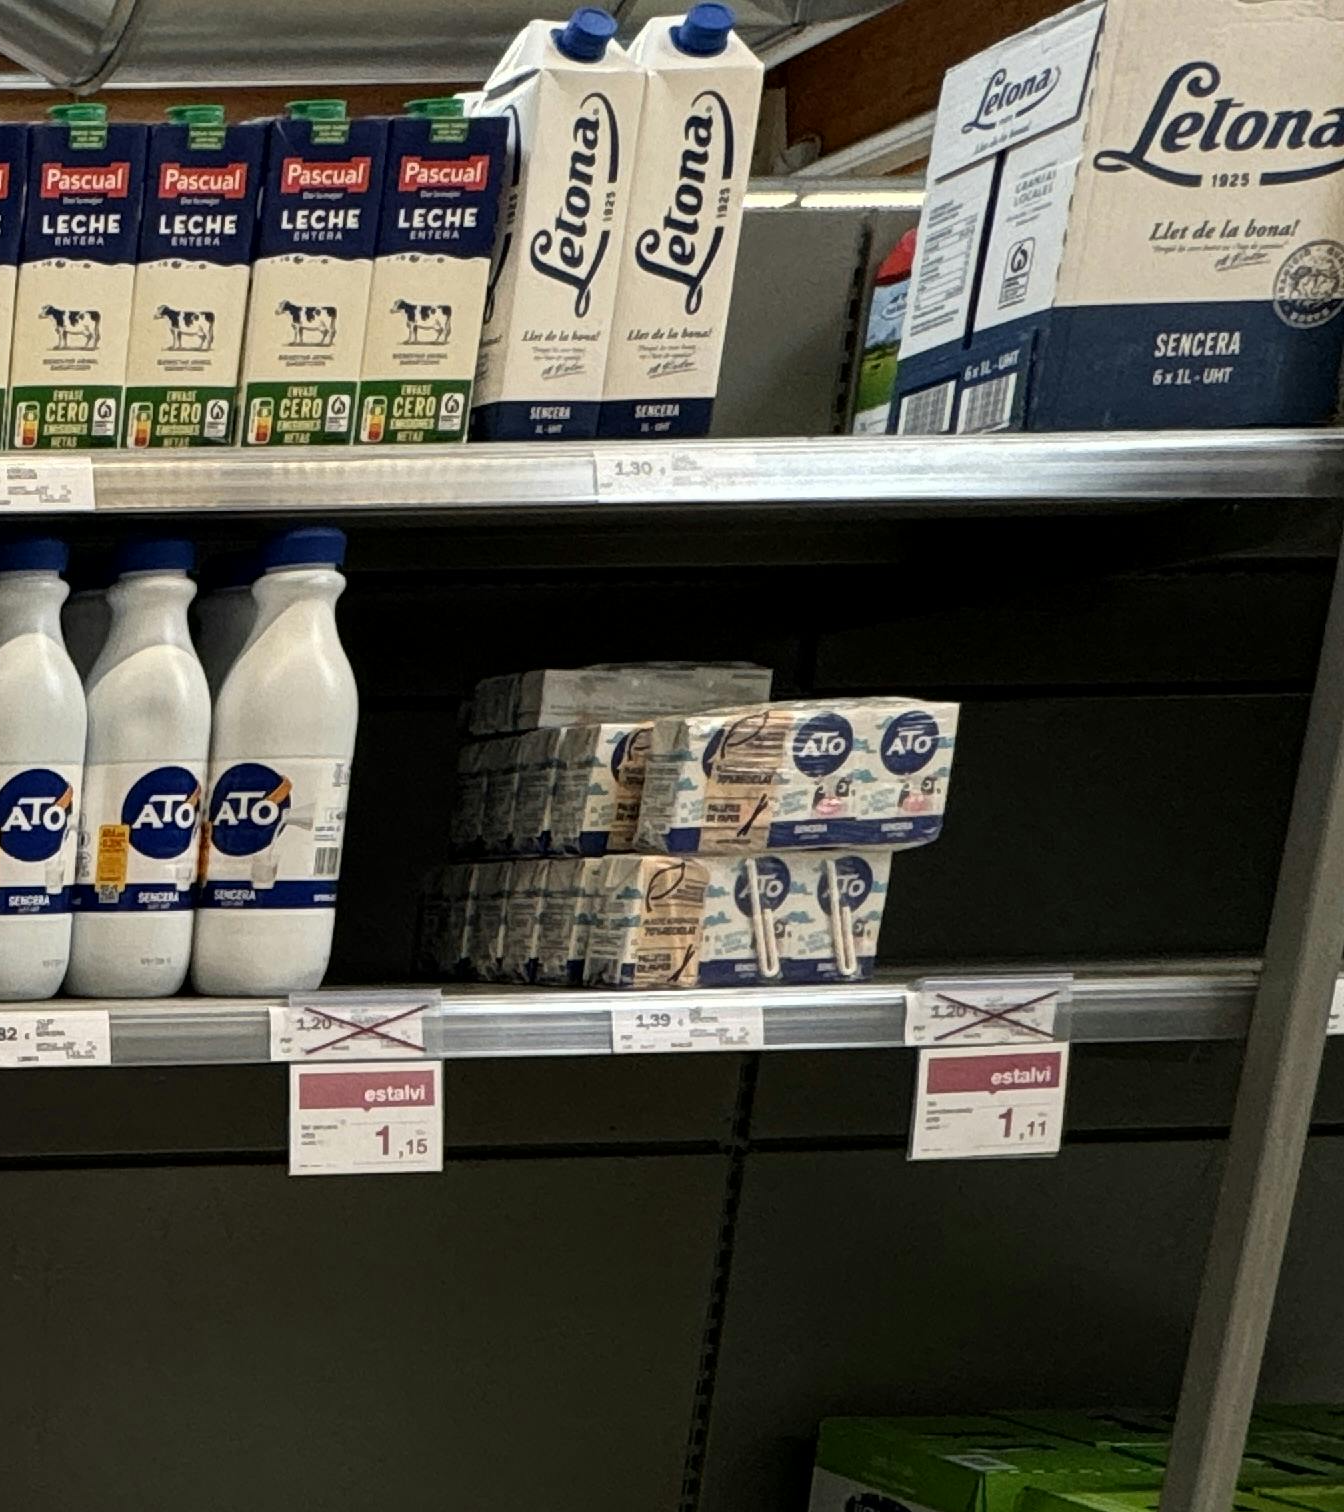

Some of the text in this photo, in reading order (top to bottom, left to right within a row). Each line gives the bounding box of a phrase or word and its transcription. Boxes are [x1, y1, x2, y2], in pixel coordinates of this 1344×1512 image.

[961, 67, 1053, 134] Letona
[1094, 61, 1344, 175] Letona
[44, 168, 123, 192] Pascual
[164, 168, 242, 192] Pascual
[286, 162, 366, 187] Pascual
[1211, 172, 1250, 188] 1925
[42, 212, 121, 236] LECHE
[158, 214, 238, 236] LECHE
[280, 208, 361, 231] LECHE
[398, 206, 478, 230] LECHE
[530, 113, 600, 318] Letona
[635, 113, 714, 315] Letona
[1149, 218, 1301, 241] Llet de la bona!
[1154, 331, 1241, 358] SENCERA
[45, 398, 89, 424] CERO
[159, 398, 202, 424] CERO
[613, 460, 653, 477] 1,30
[0, 796, 67, 832] ATO
[132, 794, 195, 830] ATO
[213, 790, 278, 826] ATO
[635, 1013, 672, 1030] 1,39
[990, 1065, 1051, 1086] estalvi
[364, 1084, 427, 1103] estalvi
[997, 1107, 1048, 1141] 1,11
[374, 1124, 428, 1159] 1,15
